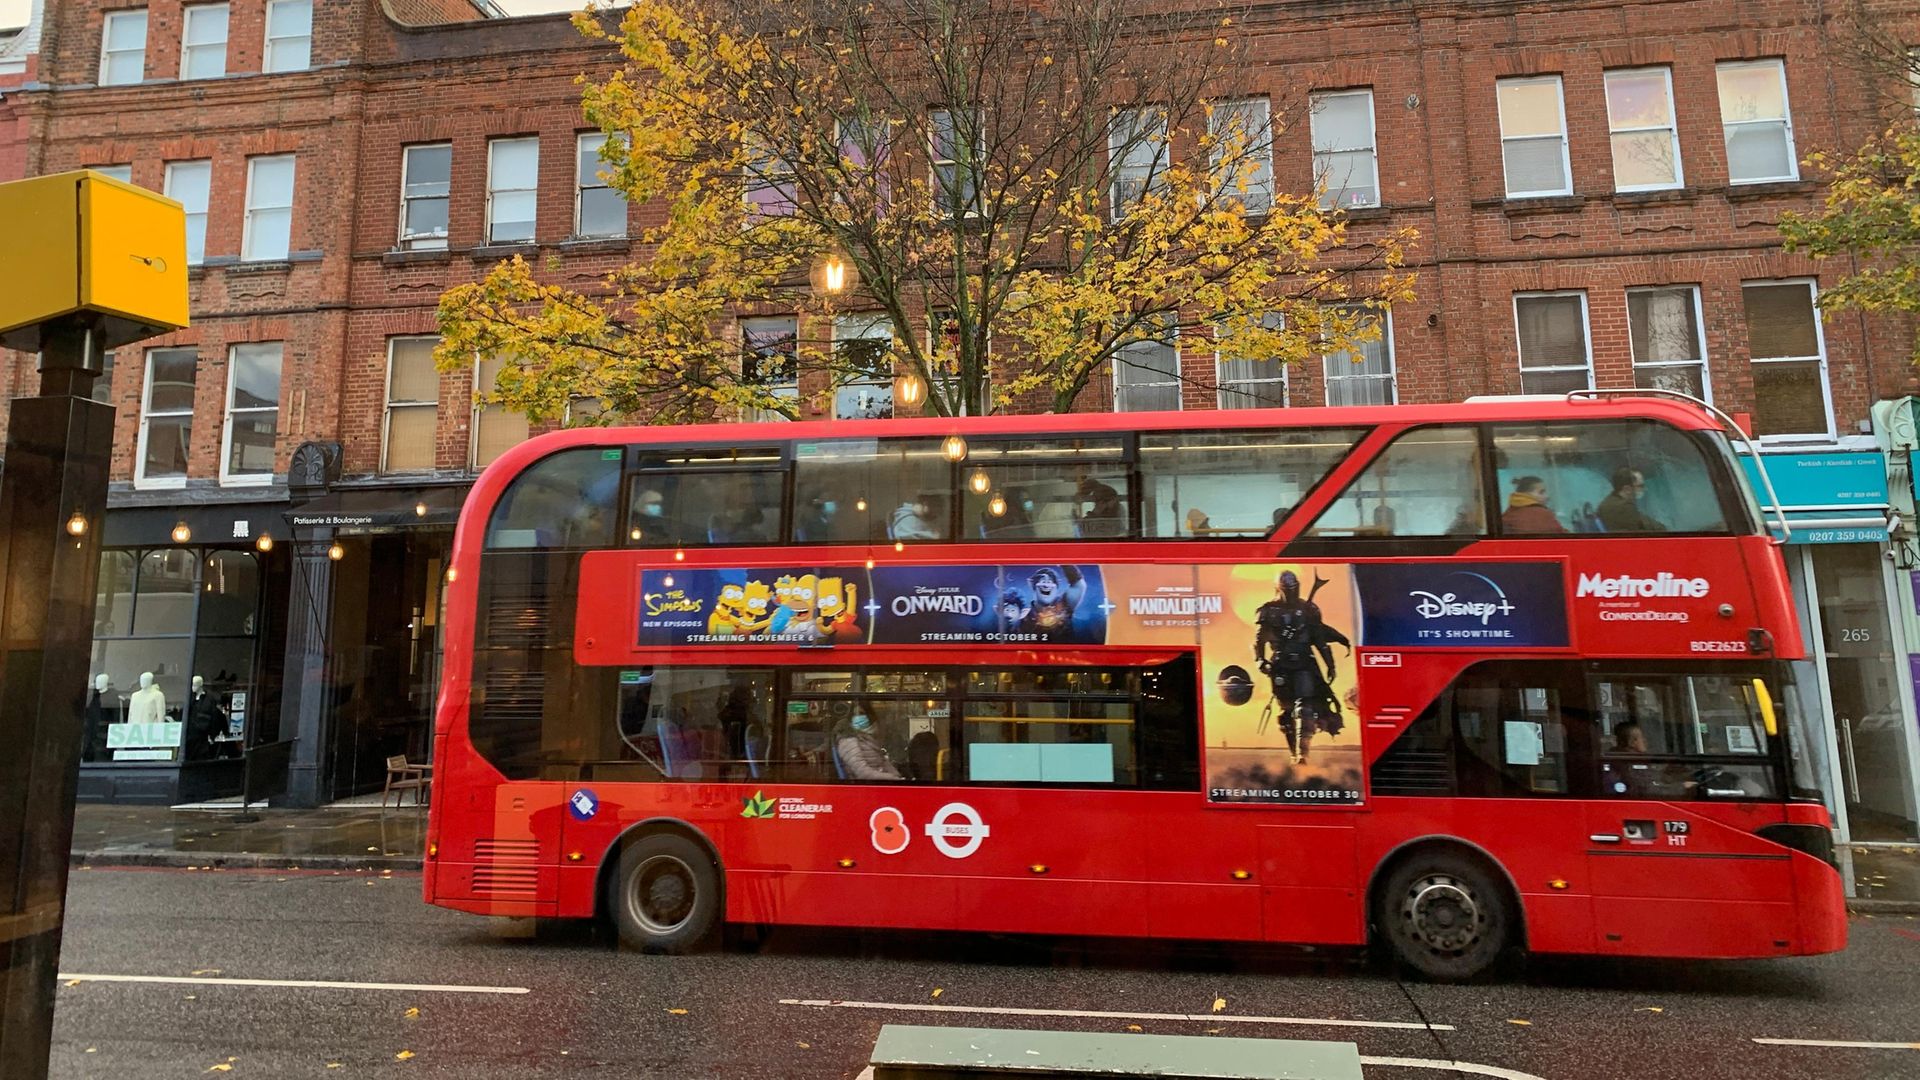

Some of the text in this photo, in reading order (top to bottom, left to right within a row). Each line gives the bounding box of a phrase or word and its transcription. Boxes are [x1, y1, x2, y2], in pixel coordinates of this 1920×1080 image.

[294, 517, 325, 525] Patisserie
[333, 516, 372, 525] Boulangerie
[1809, 530, 1883, 541] 0207 359 0405
[1576, 572, 1710, 599] Metroline
[665, 590, 685, 599] THE
[644, 593, 704, 617] SIMPSONS
[891, 594, 983, 617] ONWARD
[1129, 596, 1222, 615] MANDALORIAN
[686, 634, 746, 642] STREAMING
[748, 634, 805, 642] NOVEMBER
[920, 633, 982, 641] STREAMING
[986, 633, 1038, 641] OCTOBER
[1418, 630, 1514, 638] IT'S SHOWTIME.
[1841, 628, 1870, 642] 265
[1690, 641, 1747, 652] BDE2623
[109, 723, 178, 746] SALE
[1211, 788, 1360, 799] STREAMING OCTOBER 30
[945, 826, 969, 834] BUSES
[1663, 821, 1688, 833] 179
[1667, 835, 1688, 846] HT
